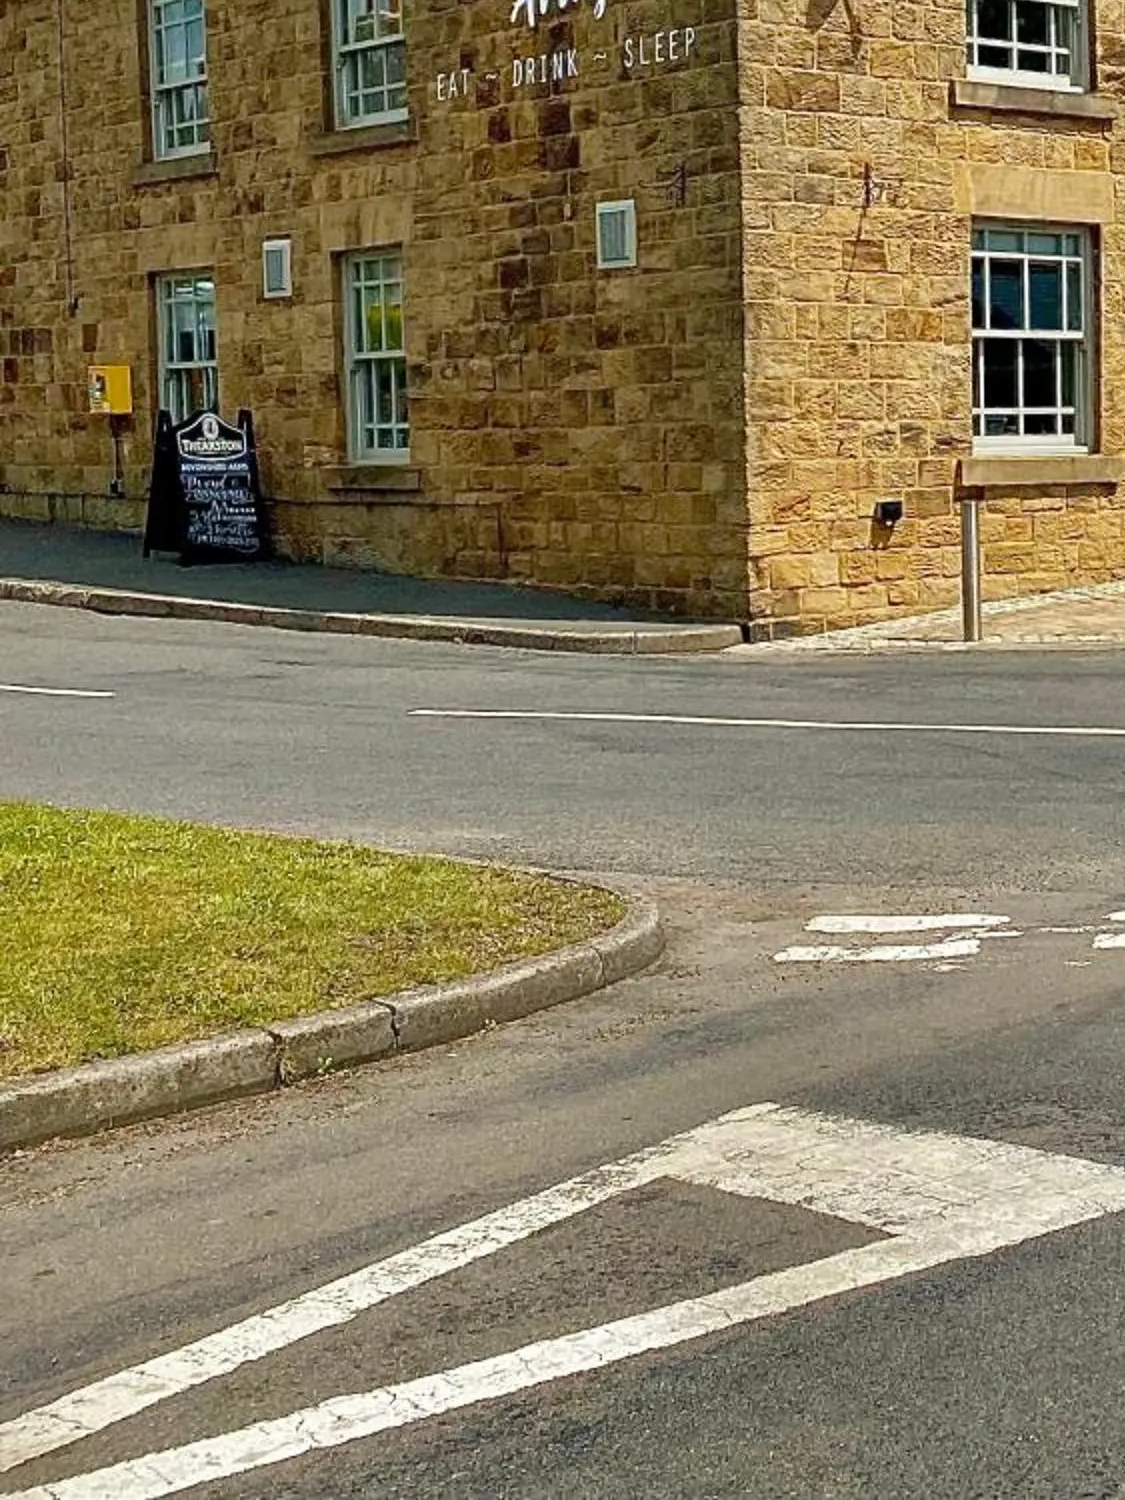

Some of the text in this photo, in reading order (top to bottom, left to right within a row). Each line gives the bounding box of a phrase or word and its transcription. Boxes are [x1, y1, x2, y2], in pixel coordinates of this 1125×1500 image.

[436, 68, 471, 102] EAT
[511, 49, 579, 88] DRINK
[623, 27, 696, 69] SLEEP
